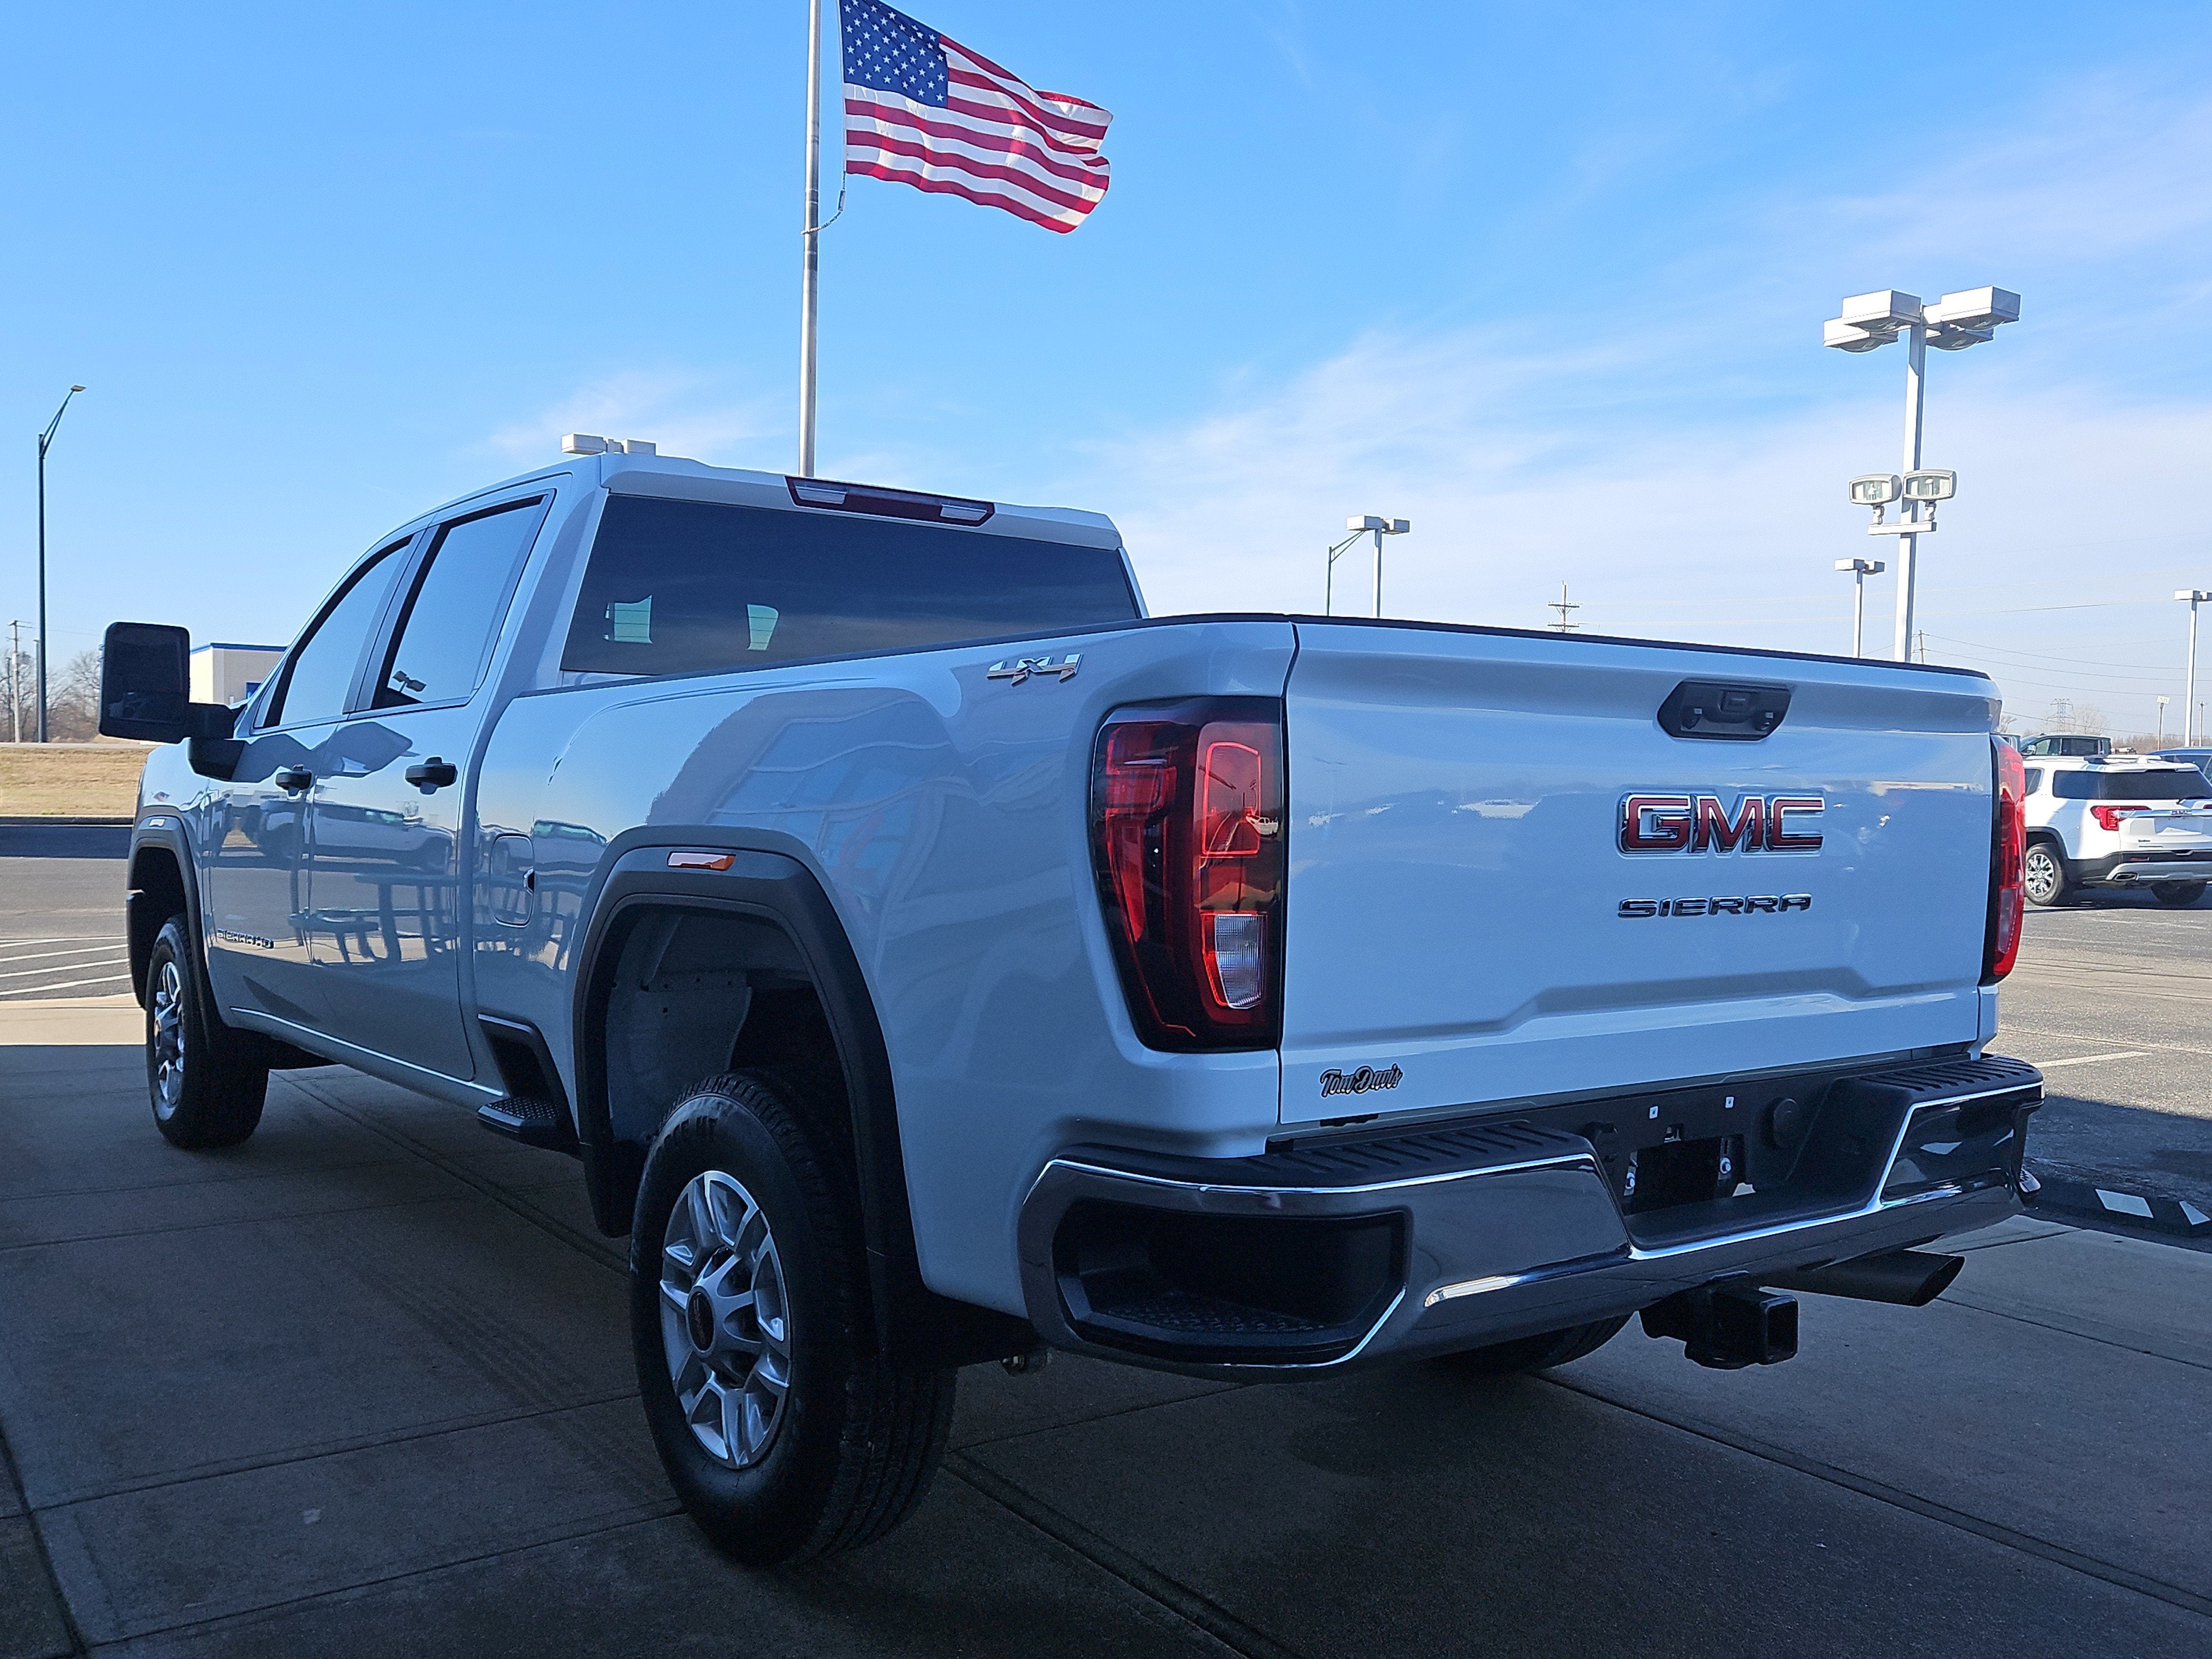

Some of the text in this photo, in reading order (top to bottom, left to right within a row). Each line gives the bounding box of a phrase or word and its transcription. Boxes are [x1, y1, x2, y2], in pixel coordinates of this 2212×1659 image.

[1620, 793, 1825, 854] GMC
[1618, 893, 1812, 917] SIERRA
[1320, 1063, 1403, 1098] Tom Davis
